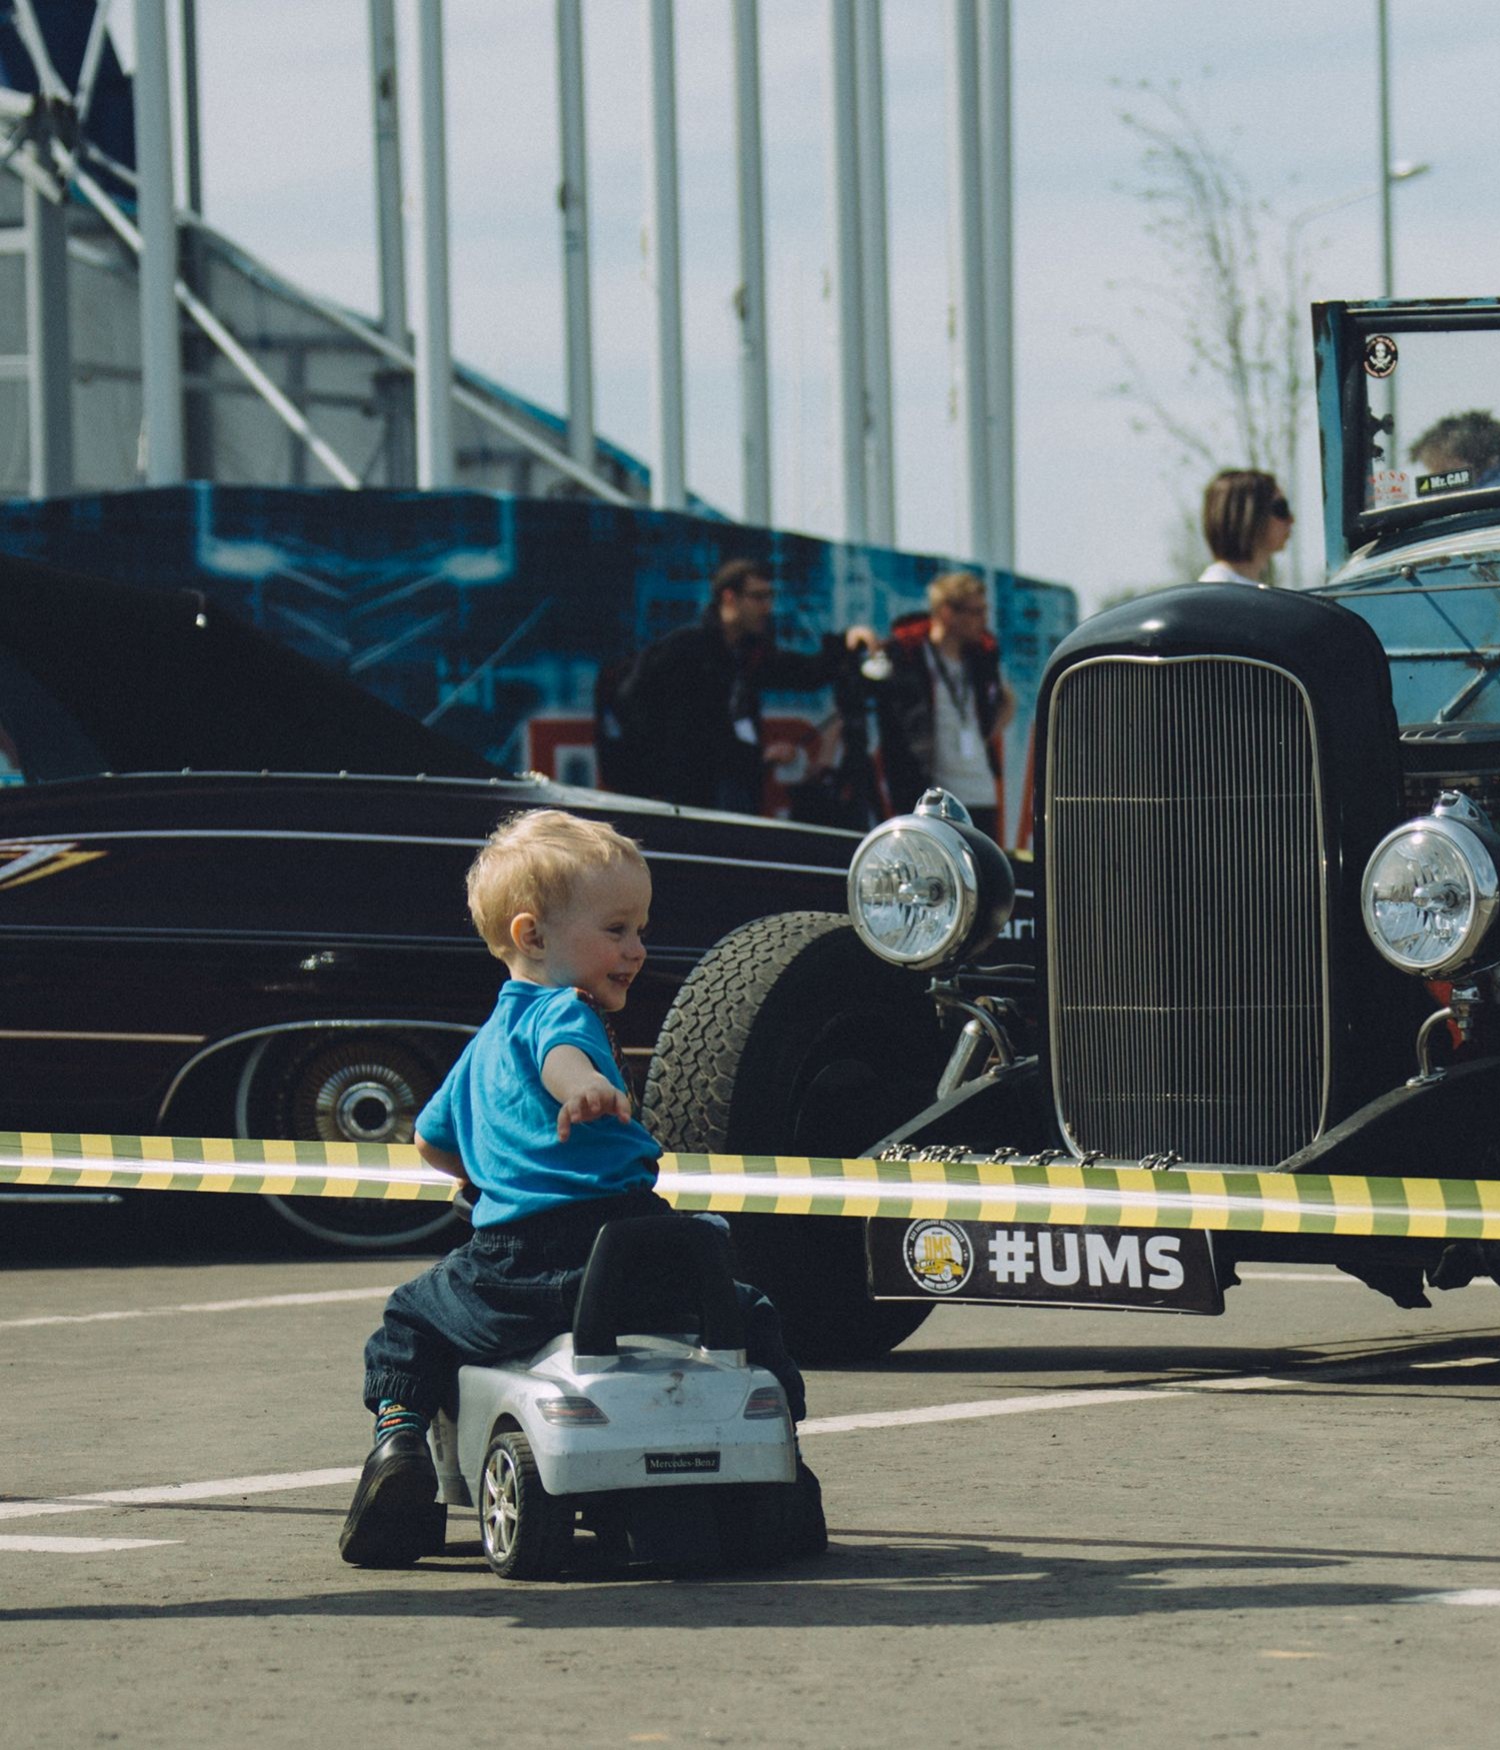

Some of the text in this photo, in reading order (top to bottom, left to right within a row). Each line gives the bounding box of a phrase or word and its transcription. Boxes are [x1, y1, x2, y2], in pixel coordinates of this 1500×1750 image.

[924, 1235, 952, 1260] UMS
[988, 1230, 1185, 1290] #UMS
[649, 1457, 716, 1468] Mercedes-Benz
